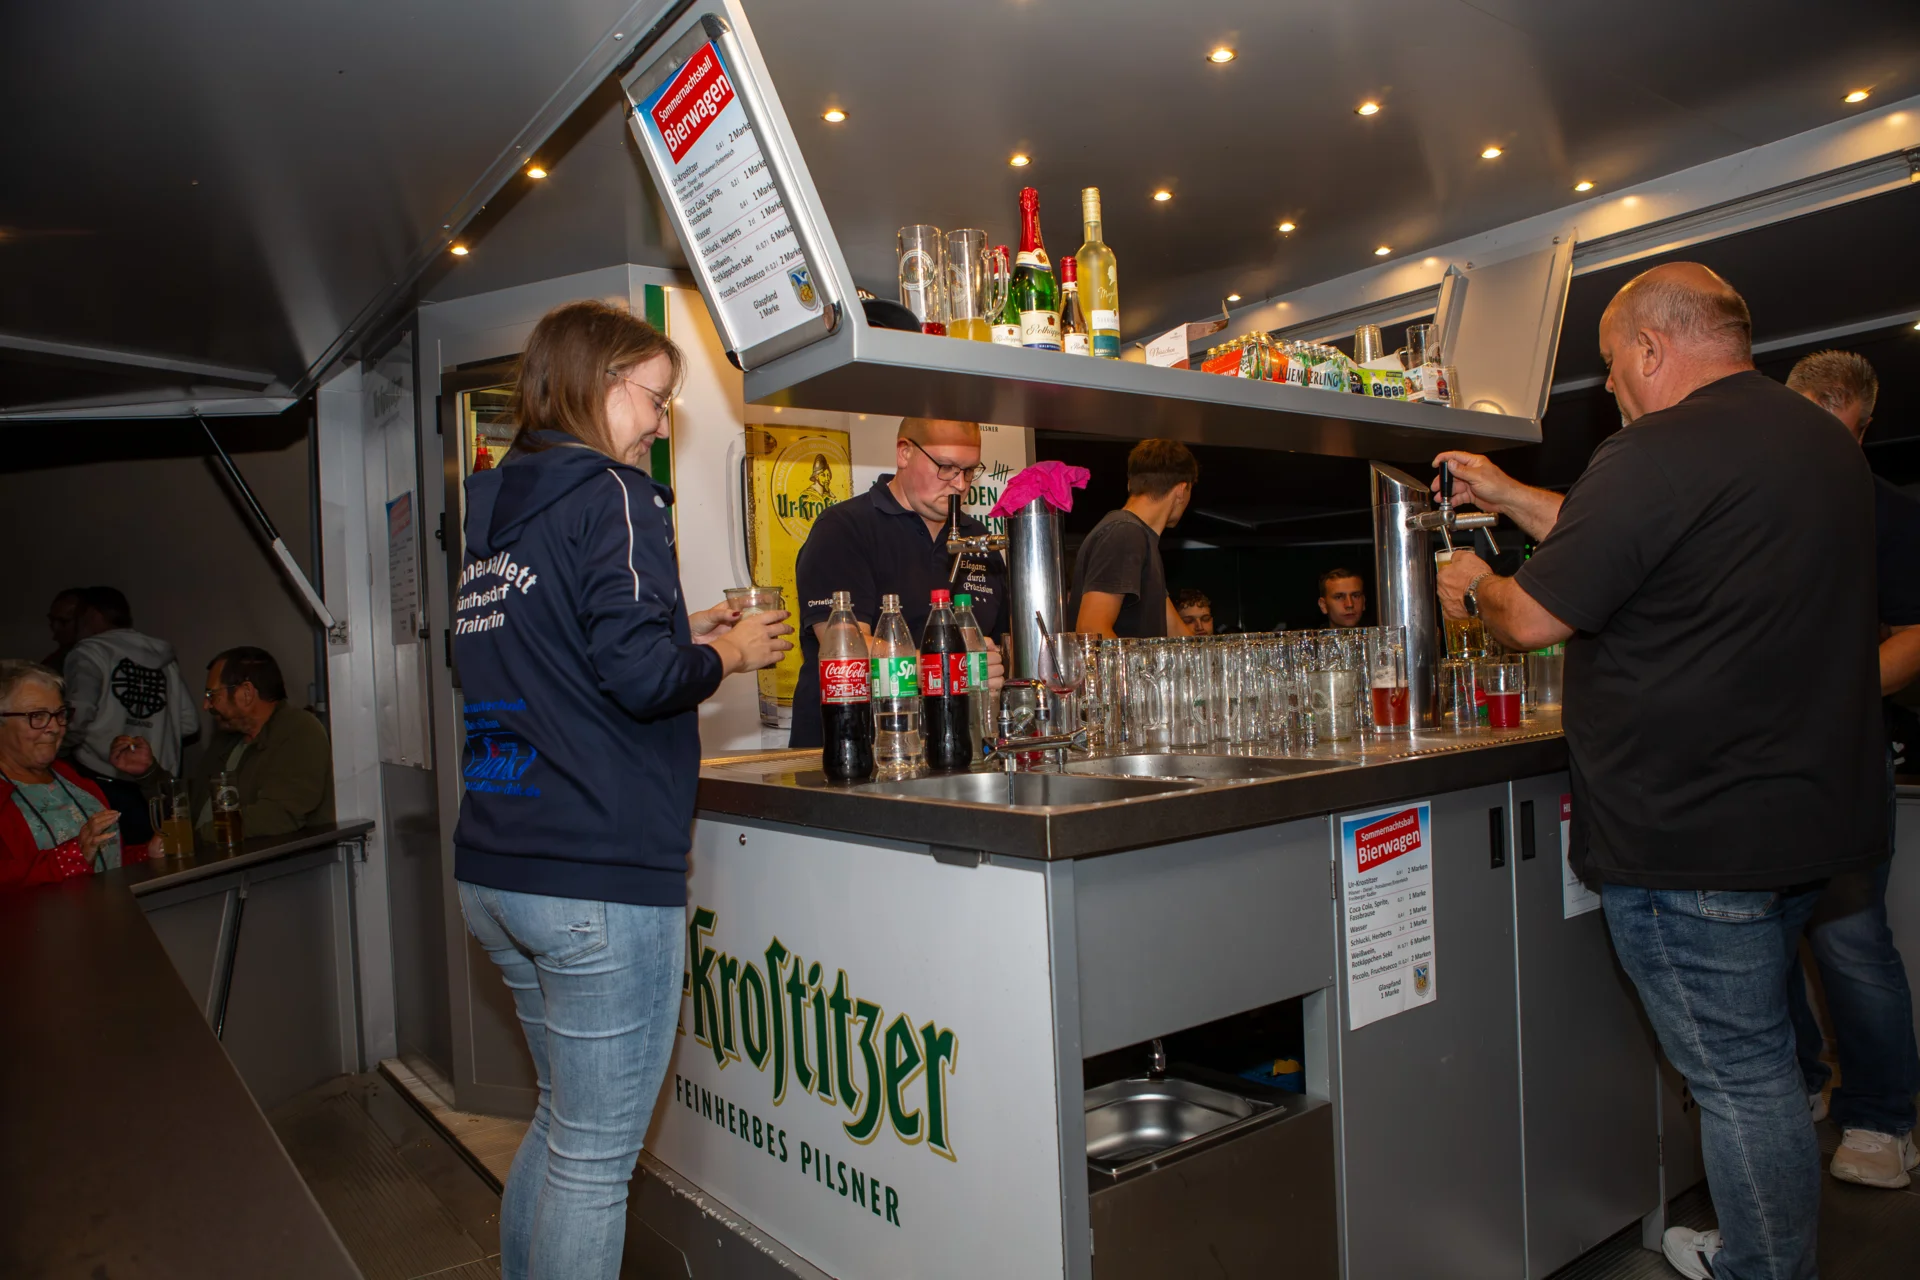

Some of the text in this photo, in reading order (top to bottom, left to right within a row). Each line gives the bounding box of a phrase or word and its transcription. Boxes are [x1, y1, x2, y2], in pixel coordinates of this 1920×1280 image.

[658, 54, 712, 122] Sommernachtsball
[664, 74, 730, 152] Bierwagen
[672, 161, 699, 187] Ur-Krostitzer
[729, 134, 734, 143] 2
[684, 205, 696, 218] Coca
[695, 197, 708, 210] Cola,
[706, 186, 723, 204] Sprite,
[744, 171, 749, 179] 1
[688, 207, 713, 227] Fassbrause
[695, 226, 712, 241] Wasser
[753, 192, 758, 200] 1
[701, 240, 722, 258] Schlucki,
[720, 227, 742, 246] Herberts
[761, 211, 766, 219] 1
[708, 254, 733, 273] Weißwein,
[713, 255, 754, 285] Rotkäppchen Sekt
[719, 285, 738, 299] Piccolo,
[736, 269, 766, 290] Fruchtsecco
[753, 290, 779, 309] Glaspfand
[763, 303, 780, 316] Marke
[1278, 365, 1339, 388] KUEMERLING
[960, 560, 986, 572] Eleganz
[966, 572, 986, 582] durch
[963, 582, 993, 594] Präzision
[808, 598, 835, 607] Christia
[1361, 815, 1414, 842] Sommernachtsball
[1358, 830, 1420, 864] Bierwagen
[1348, 876, 1378, 888] Ur-Krostitzer
[1411, 863, 1428, 872] Marken
[1349, 906, 1361, 914] Coca
[1361, 902, 1373, 911] Cola,
[1374, 898, 1389, 908] Sprite,
[1412, 890, 1426, 898] Marke
[1349, 909, 1375, 922] Fassbrause
[1350, 923, 1367, 934] Wasser
[1412, 905, 1427, 914] Marke
[1350, 936, 1371, 947] Schlucki,
[1371, 930, 1392, 941] Herberts
[1413, 919, 1427, 927] Marke
[1351, 947, 1376, 960] Weißwein,
[1413, 935, 1431, 944] Marken
[1351, 951, 1393, 969] Rotkäppchen Sekt
[1352, 971, 1370, 982] Piccolo,
[1370, 962, 1397, 976] Fruchtsecco
[1414, 950, 1431, 960] Marken
[1378, 979, 1401, 992] Glaspfand
[1385, 988, 1400, 997] Marke
[675, 1074, 901, 1228] FEINHERBES PILSNER
